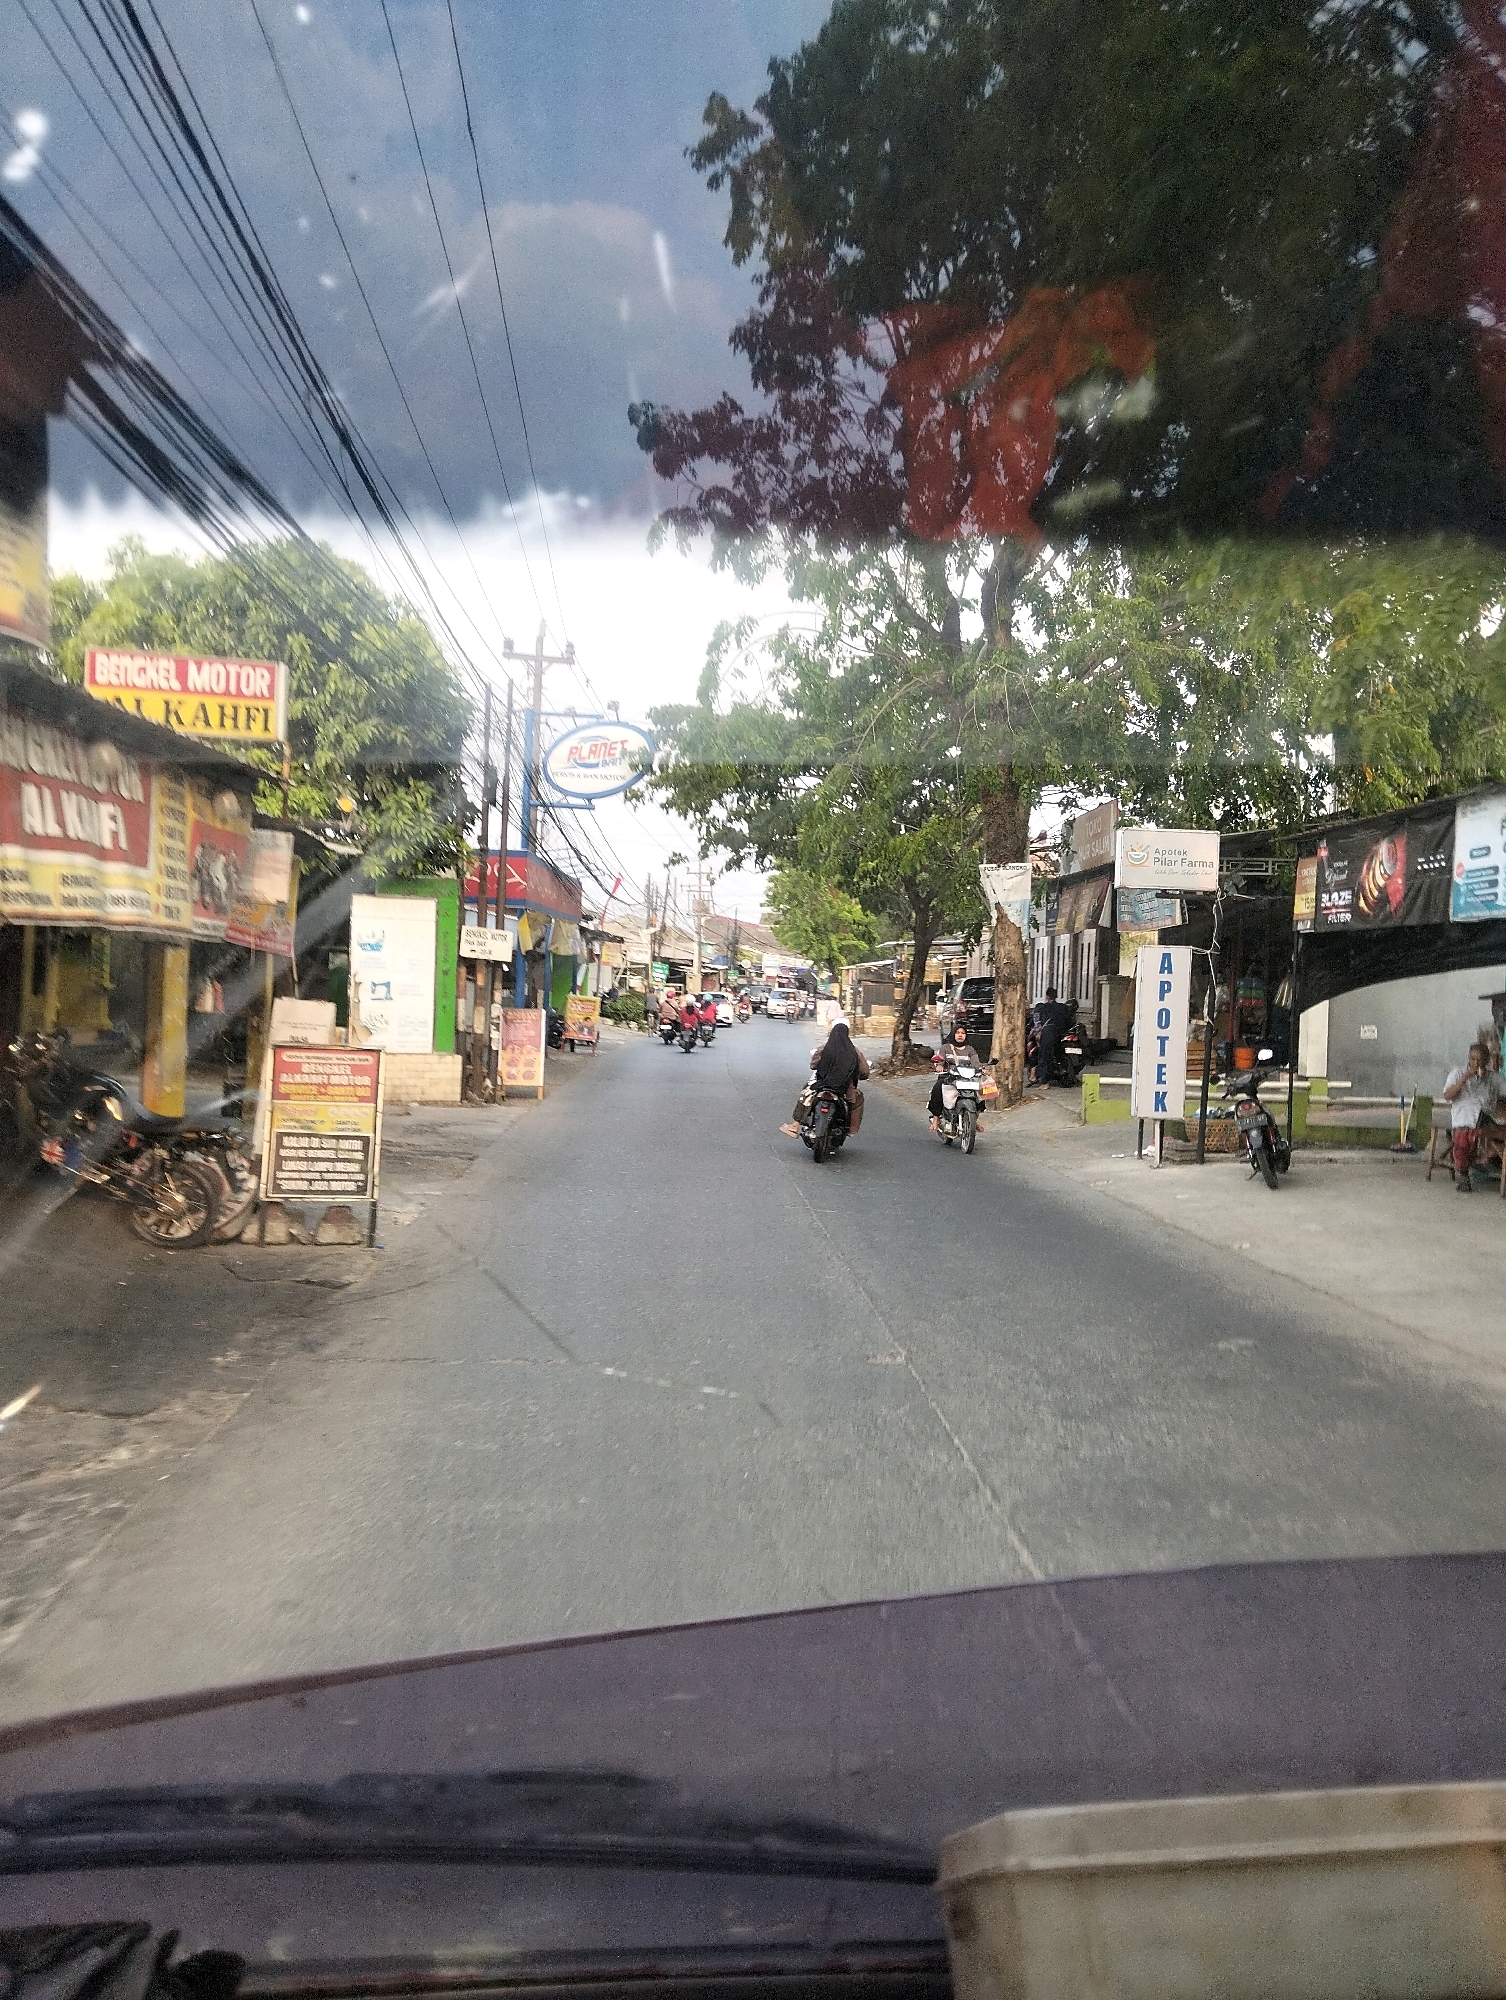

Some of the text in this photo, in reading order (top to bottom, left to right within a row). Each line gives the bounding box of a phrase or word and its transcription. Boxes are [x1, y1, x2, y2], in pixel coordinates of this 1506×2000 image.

[94, 652, 271, 698] BENGKEL MOTOR
[163, 699, 271, 733] KAHFI
[567, 739, 629, 763] PLANET
[1153, 856, 1214, 869] Pilar Farma
[1154, 848, 1188, 857] Apotek
[1154, 952, 1173, 1113] APOTEK
